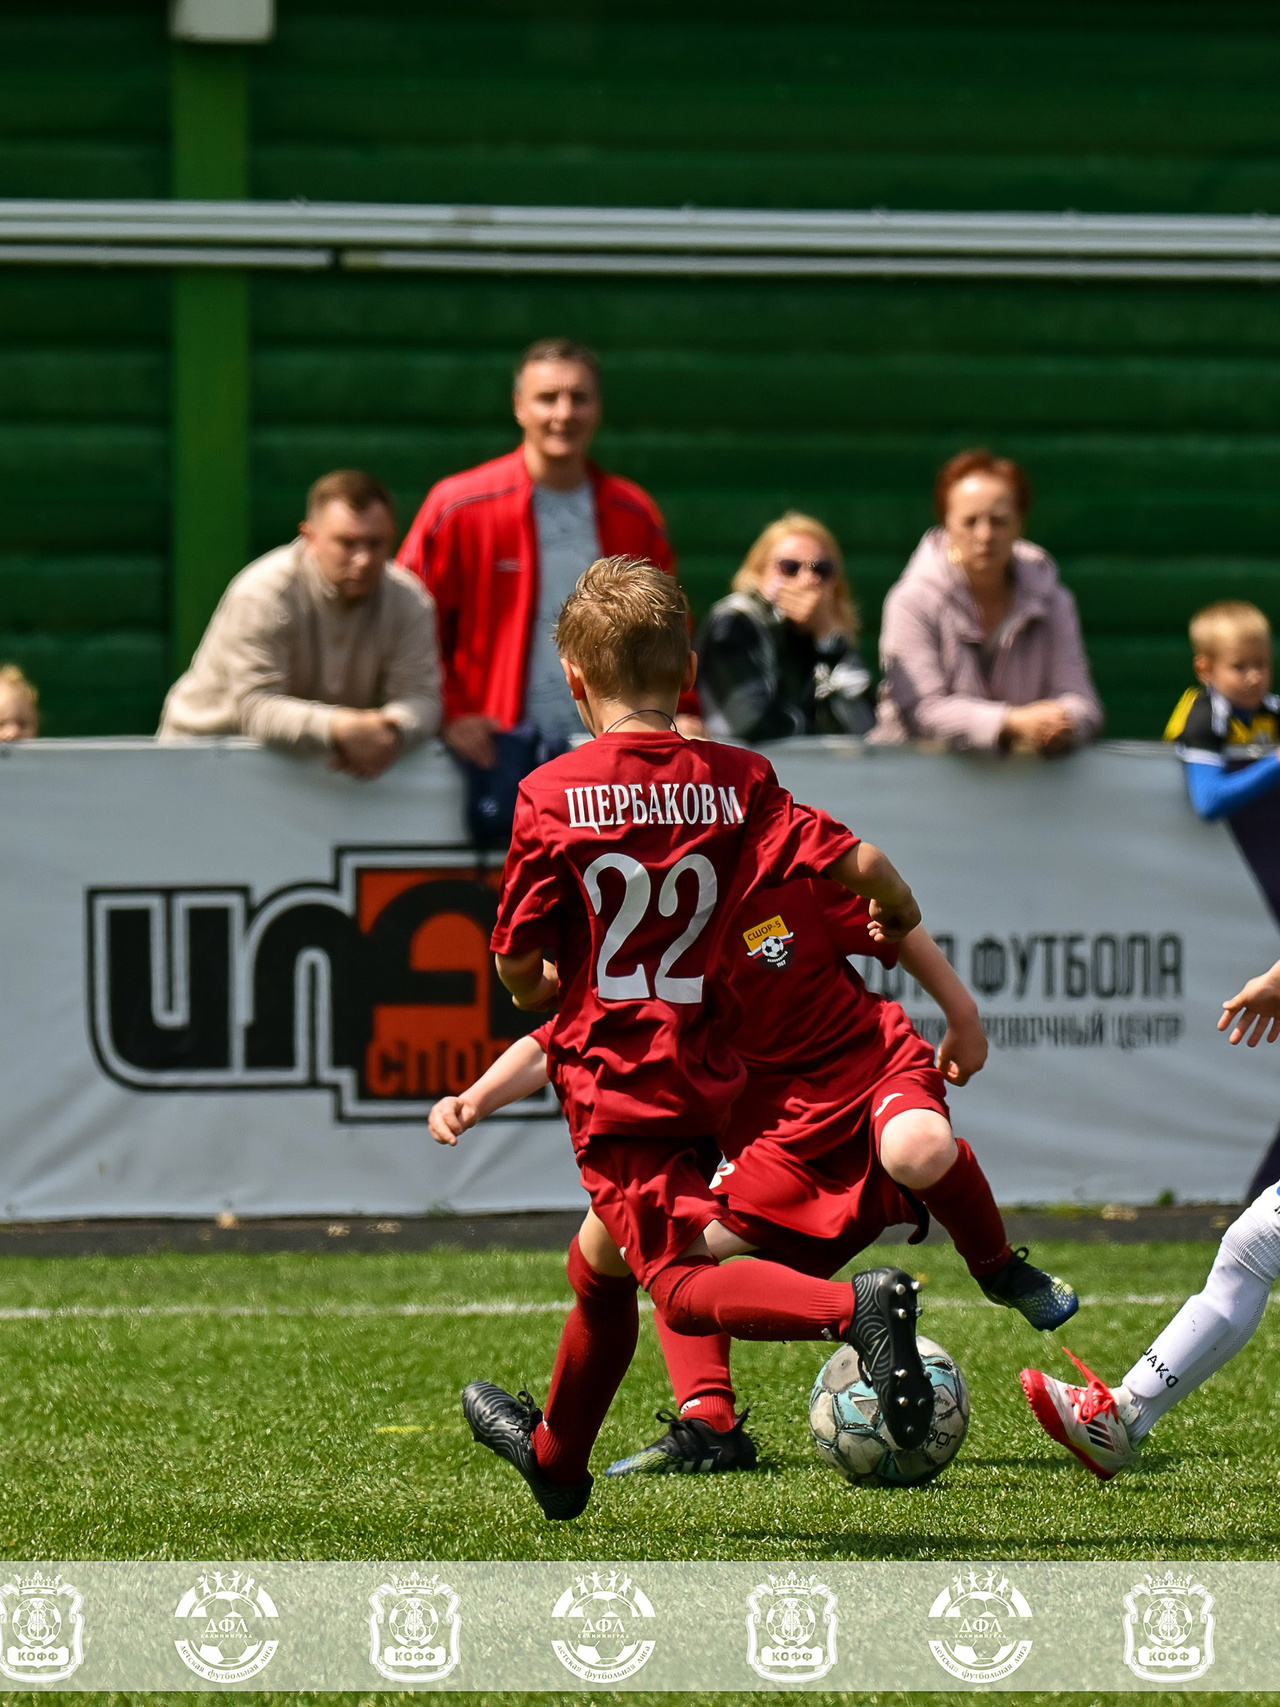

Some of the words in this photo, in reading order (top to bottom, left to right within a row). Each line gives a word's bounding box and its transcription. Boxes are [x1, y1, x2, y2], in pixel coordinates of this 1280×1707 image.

[564, 783, 717, 835] ЩЕРБАКОВ
[583, 853, 717, 1004] 22
[747, 920, 782, 941] СШОР-5
[970, 930, 1184, 999] ФУТБОЛА
[1142, 1348, 1179, 1389] JAKO
